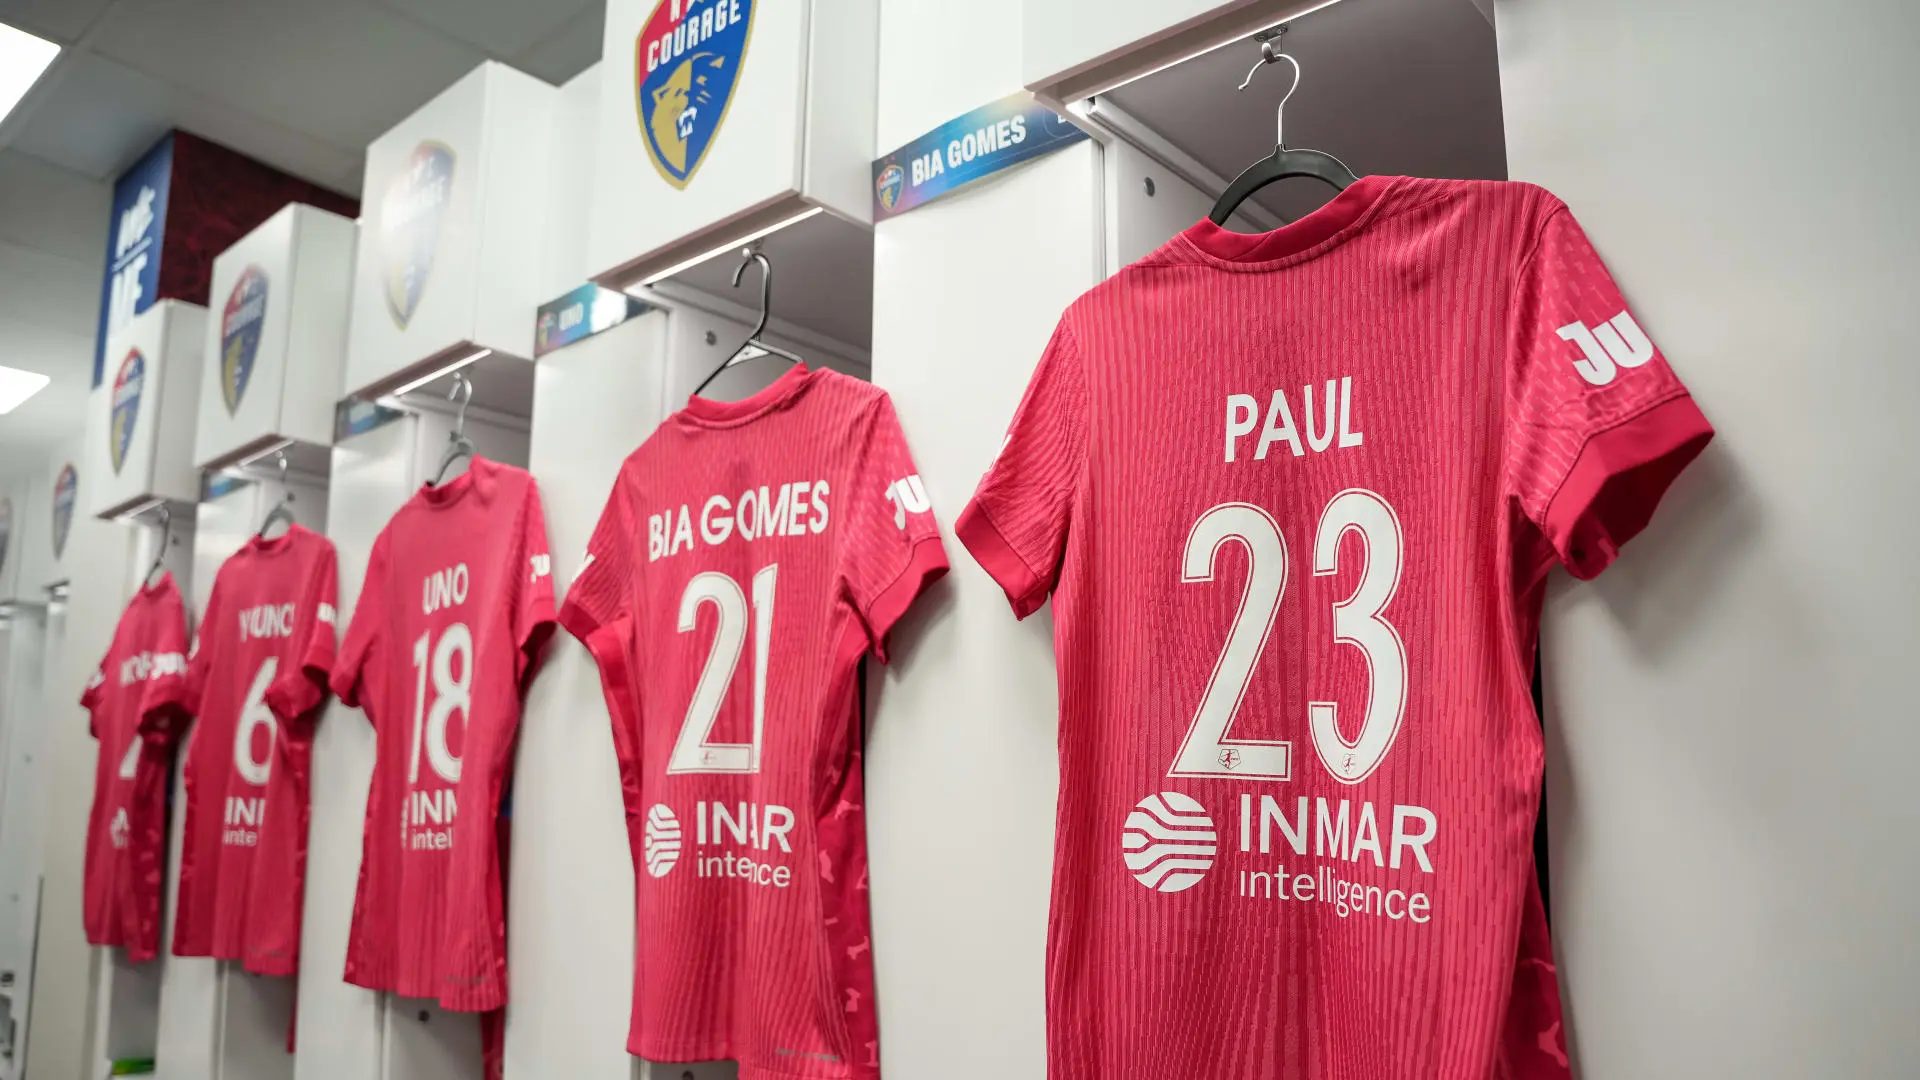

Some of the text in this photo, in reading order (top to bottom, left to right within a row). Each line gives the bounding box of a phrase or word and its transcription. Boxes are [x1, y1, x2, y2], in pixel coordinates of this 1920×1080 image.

[647, 0, 741, 72] COURAGE
[911, 148, 945, 187] BIA
[946, 114, 1028, 169] GOMES
[1555, 309, 1655, 386] JU
[1224, 376, 1363, 463] PAUL
[648, 479, 830, 563] BIA GOMES
[423, 563, 469, 615] UNO
[666, 563, 778, 776] 21
[1166, 487, 1409, 785] 23
[233, 656, 278, 786] 6
[408, 622, 473, 784] 18
[1240, 793, 1438, 873] INMAR
[1240, 866, 1433, 924] intelligence
